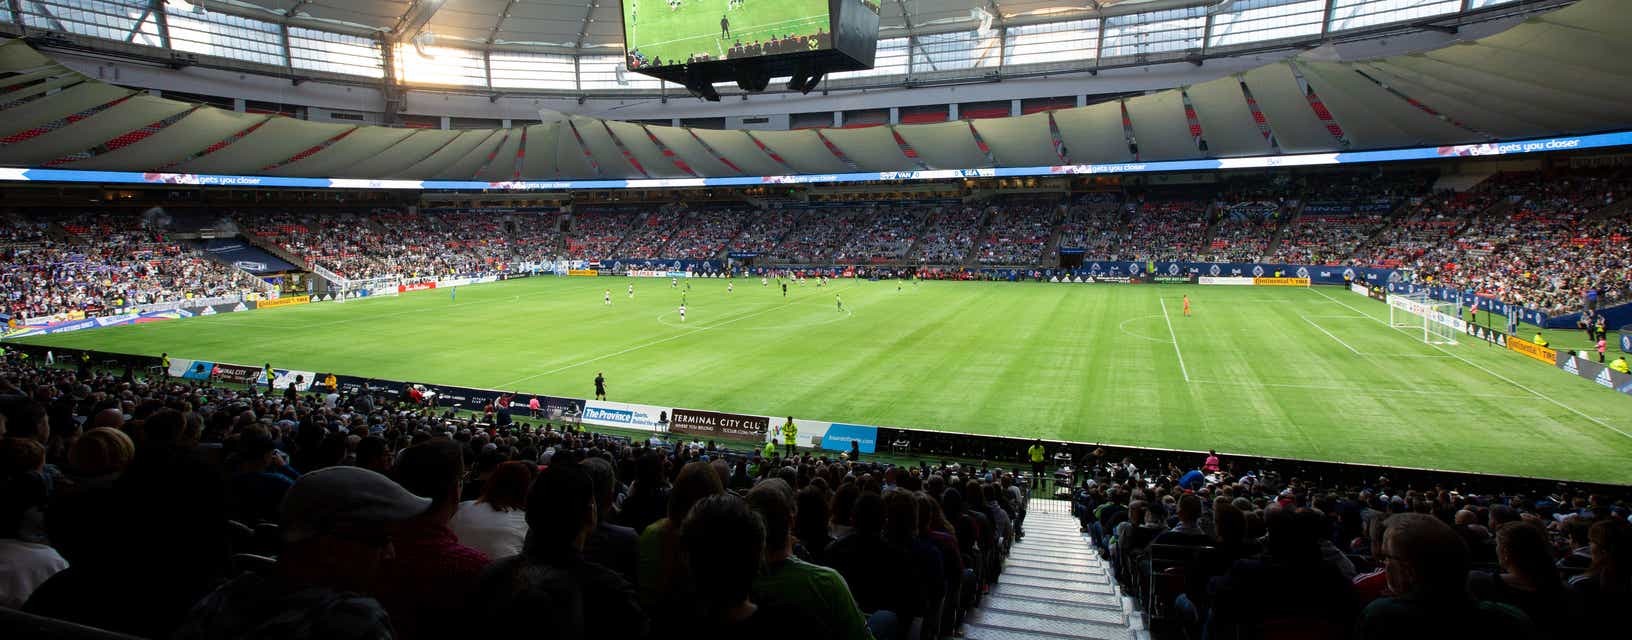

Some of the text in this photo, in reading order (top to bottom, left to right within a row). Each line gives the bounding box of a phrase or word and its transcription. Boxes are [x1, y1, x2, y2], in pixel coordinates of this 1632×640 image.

[1500, 143, 1521, 153] gets
[1523, 142, 1544, 152] you
[1546, 138, 1581, 149] closer
[1092, 166, 1107, 174] gets
[1108, 165, 1122, 173] you
[1124, 163, 1146, 171] closer
[199, 176, 218, 186] gets
[219, 176, 235, 186] you
[236, 176, 260, 185] closer
[586, 408, 599, 418] The
[600, 410, 630, 423] Province
[674, 414, 717, 425] TERMINAL
[720, 418, 741, 428] CITY
